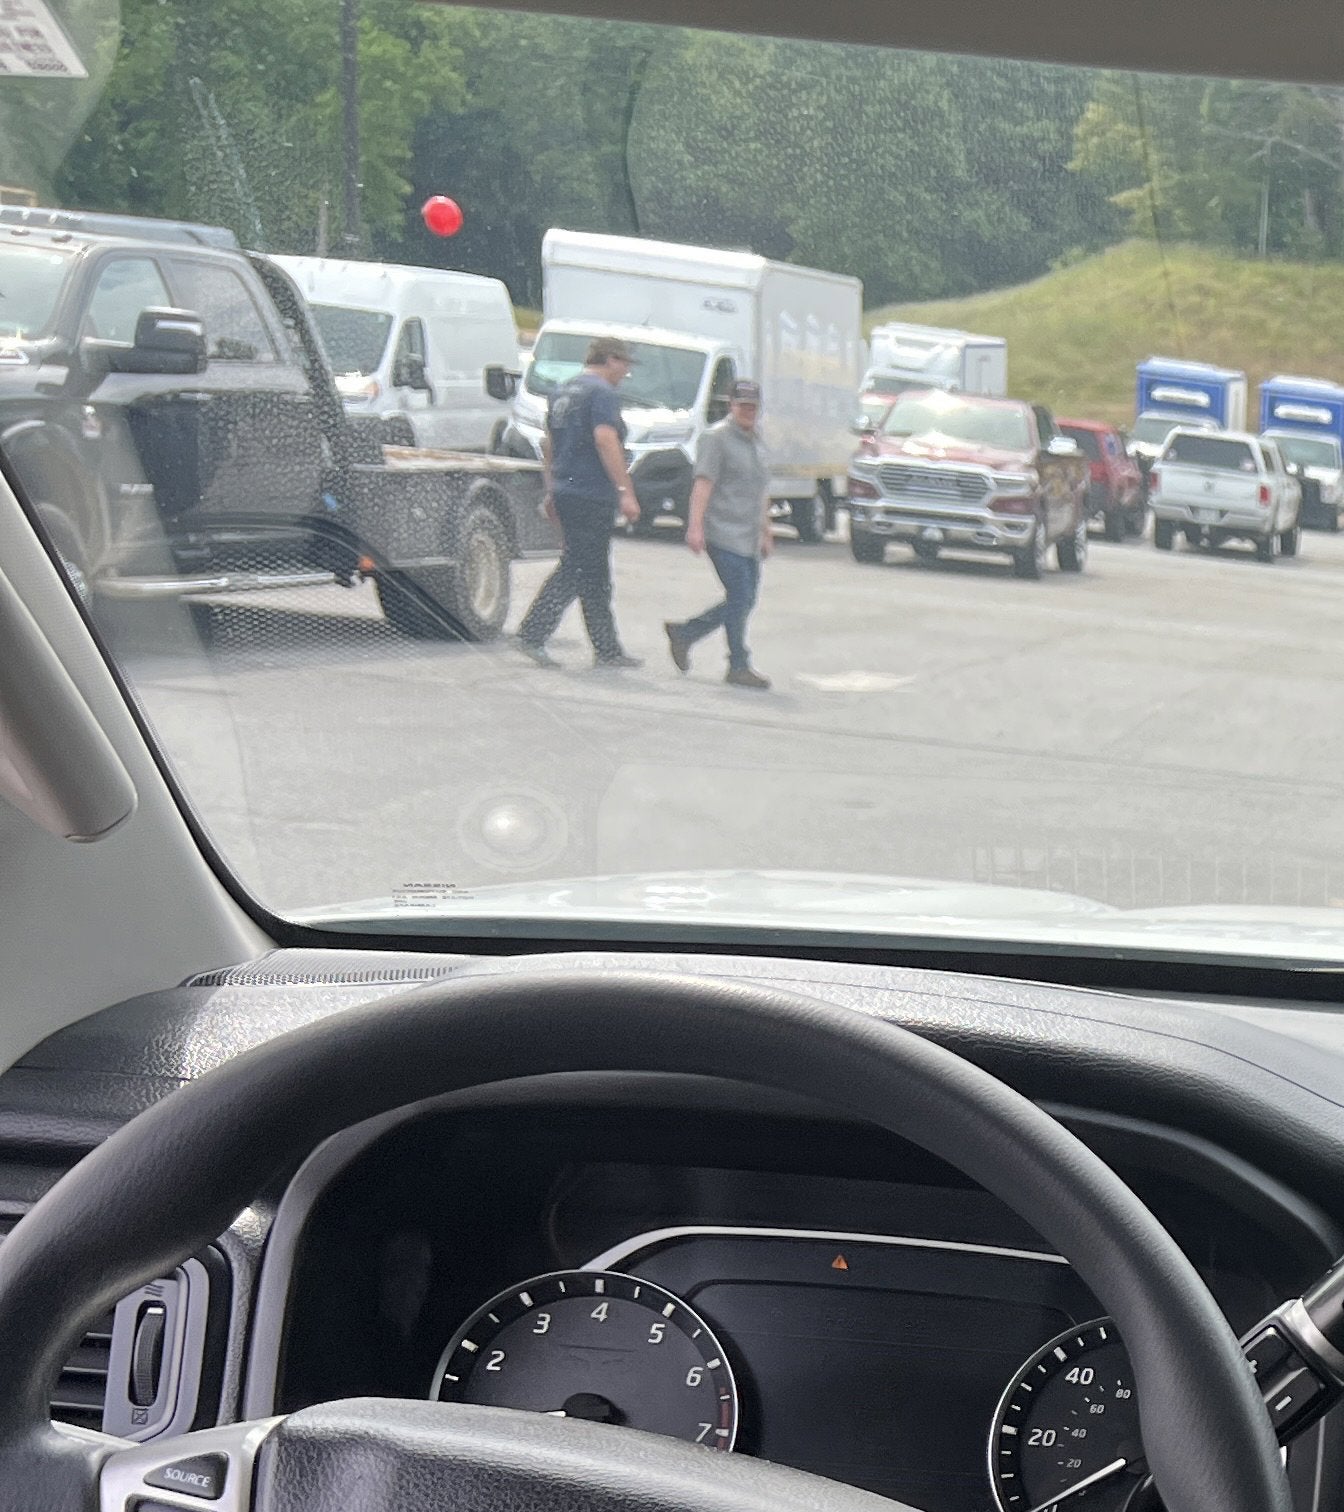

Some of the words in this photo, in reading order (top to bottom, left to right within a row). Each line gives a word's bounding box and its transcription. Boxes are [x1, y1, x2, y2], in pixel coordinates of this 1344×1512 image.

[590, 1302, 609, 1322] 4
[533, 1313, 551, 1334] 3
[648, 1323, 665, 1344] 5
[486, 1351, 505, 1371] 2
[686, 1366, 704, 1387] 6
[1065, 1367, 1094, 1385] 40
[1116, 1389, 1131, 1399] 80
[1090, 1404, 1105, 1414] 60
[696, 1423, 712, 1442] 7
[1028, 1429, 1057, 1446] 20
[1071, 1428, 1087, 1438] 40
[1066, 1458, 1081, 1468] 20
[164, 1468, 211, 1487] SOURCE
